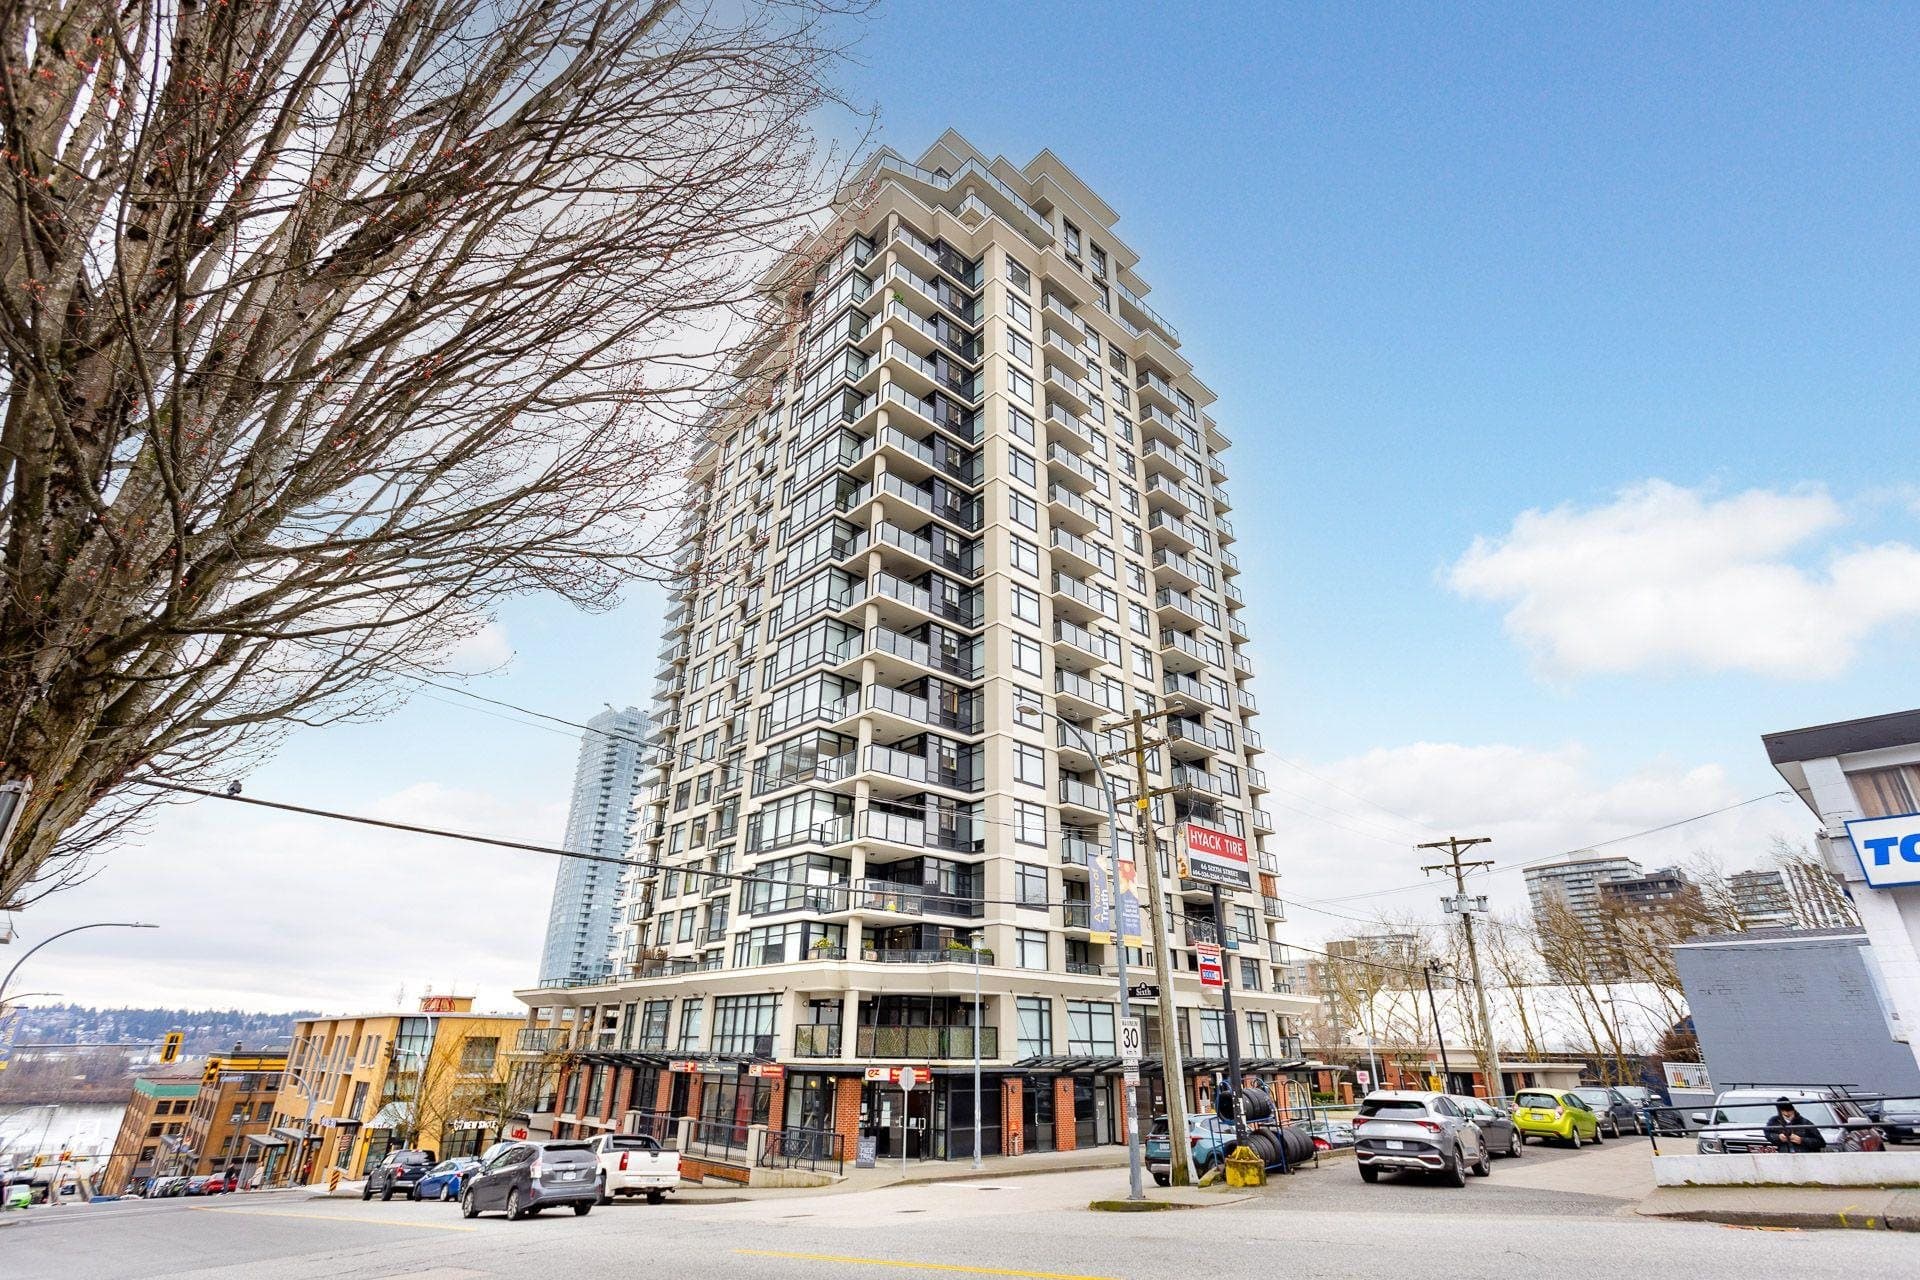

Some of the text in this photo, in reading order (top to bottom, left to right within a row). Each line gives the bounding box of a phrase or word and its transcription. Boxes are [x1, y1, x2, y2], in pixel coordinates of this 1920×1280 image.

[1190, 830, 1243, 857] HYACK TIRE
[1094, 913, 1101, 922] A
[1101, 889, 1109, 923] Truth
[1123, 1028, 1139, 1049] 30
